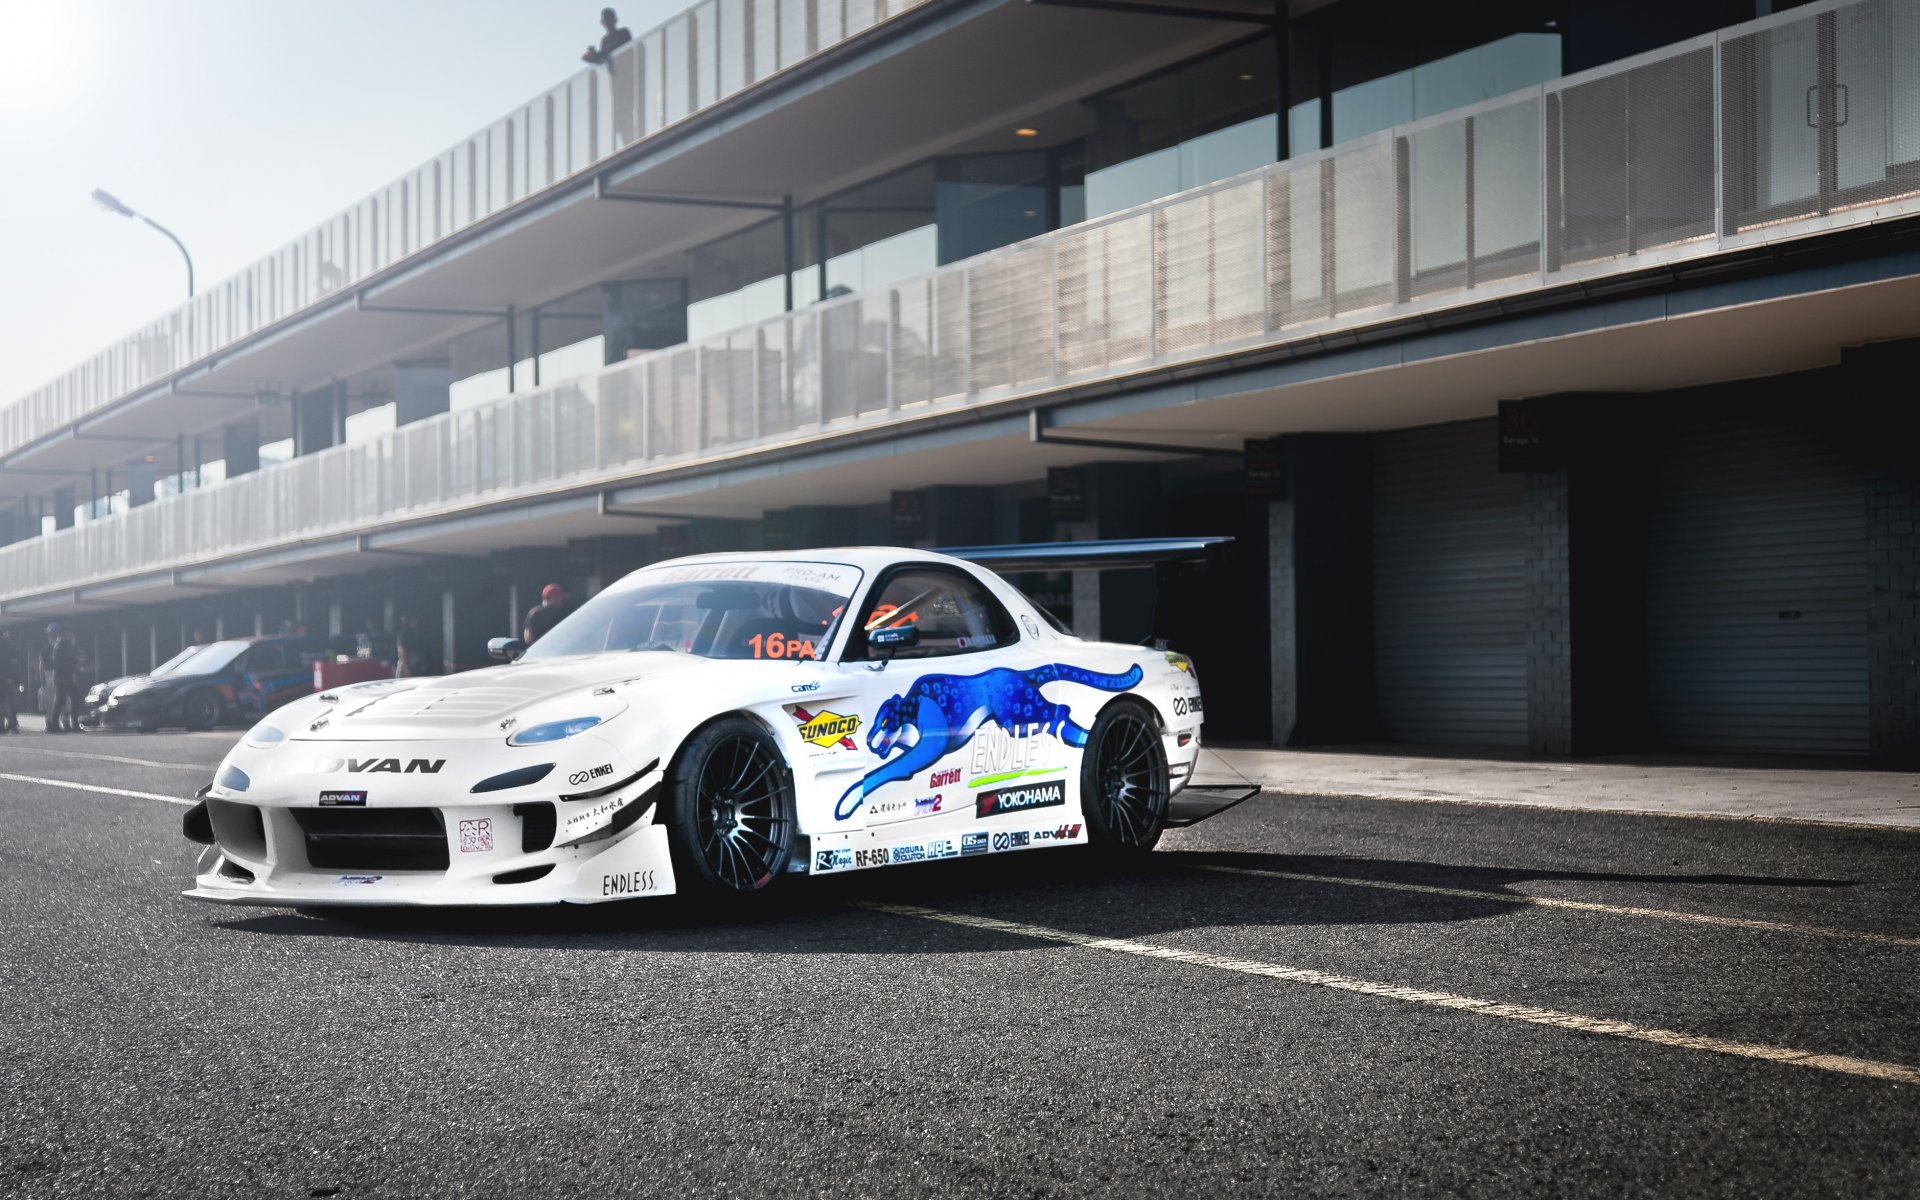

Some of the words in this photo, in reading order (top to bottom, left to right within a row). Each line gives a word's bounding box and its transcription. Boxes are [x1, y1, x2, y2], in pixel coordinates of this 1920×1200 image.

[799, 717, 857, 740] SUNOCO
[589, 763, 614, 779] ENKEI
[320, 794, 361, 802] ADVAN
[997, 785, 1061, 809] YOKOHAMA
[855, 848, 889, 867] RF-650
[900, 845, 924, 854] OGURA
[900, 853, 926, 861] CLUTCH
[603, 870, 654, 896] ENDLESS
